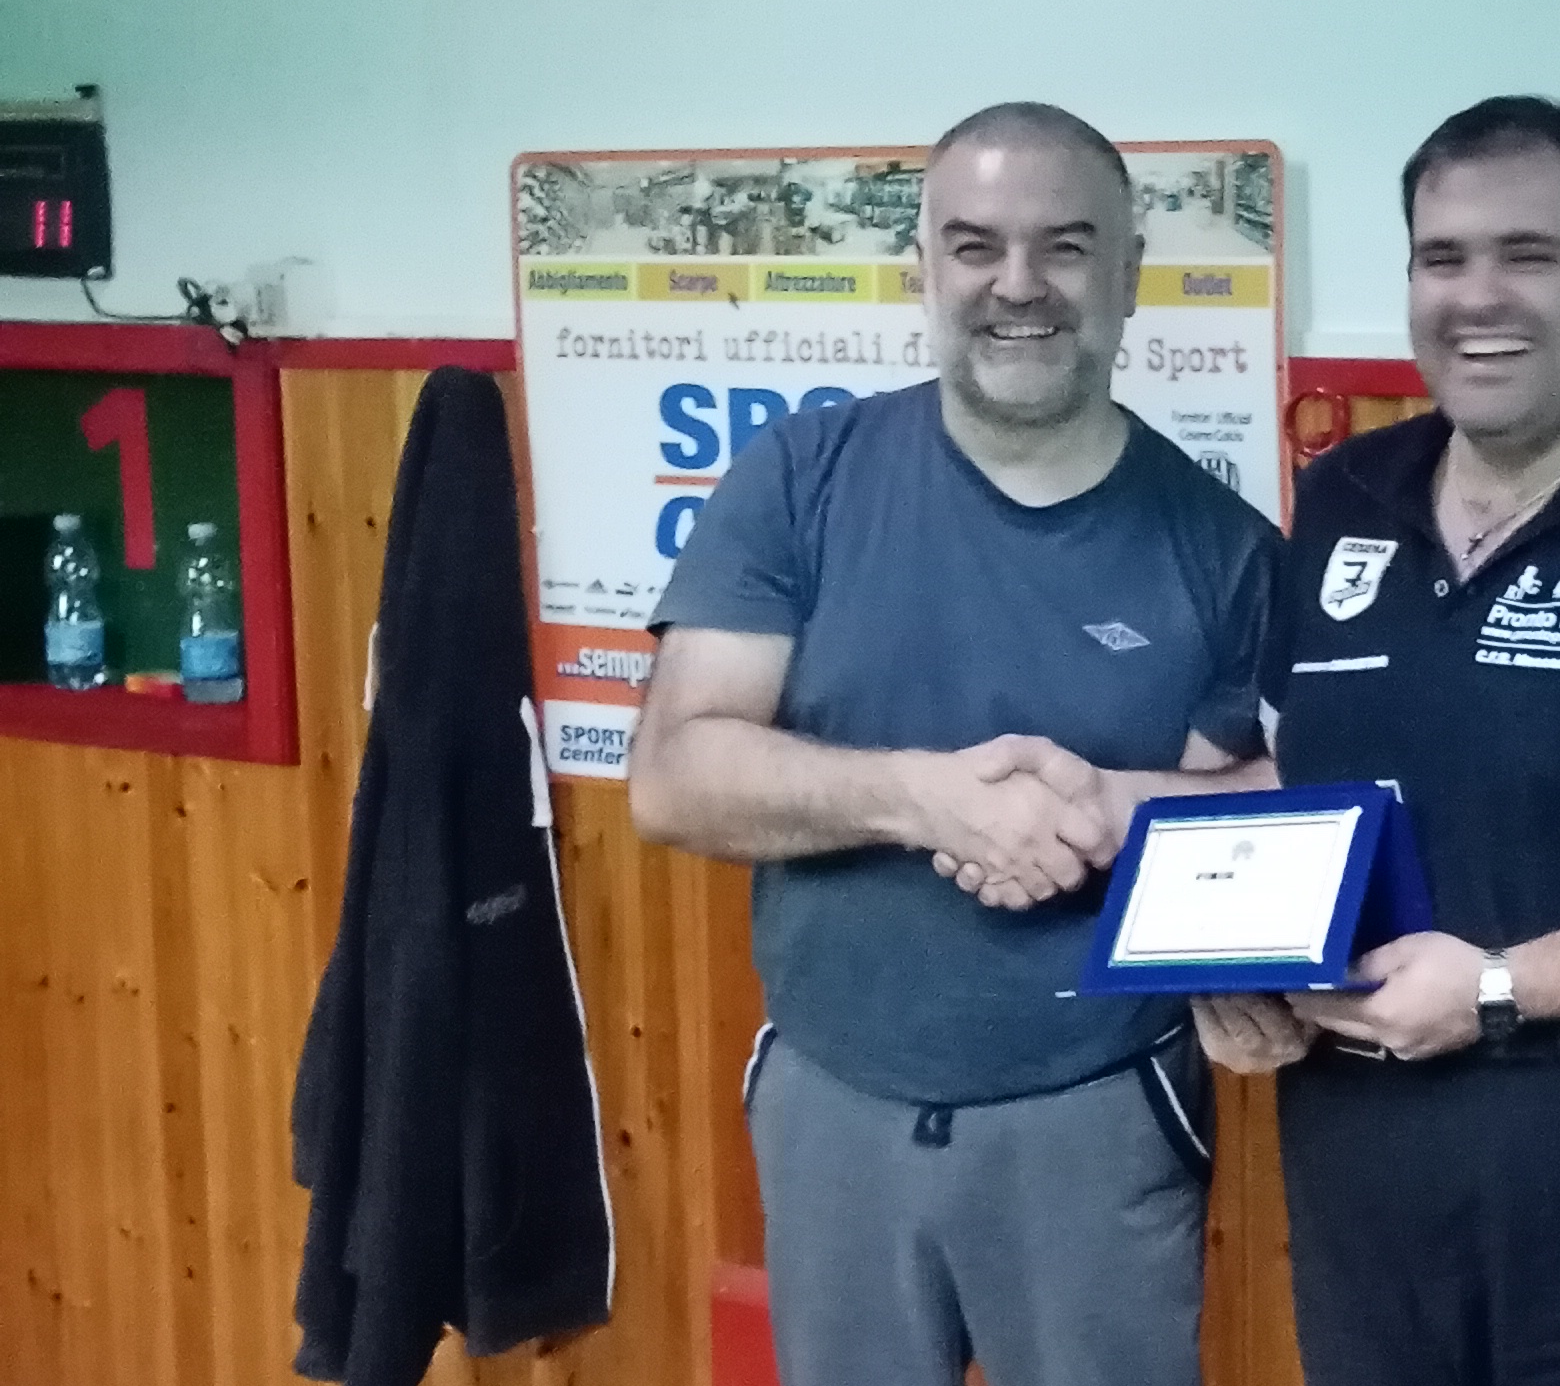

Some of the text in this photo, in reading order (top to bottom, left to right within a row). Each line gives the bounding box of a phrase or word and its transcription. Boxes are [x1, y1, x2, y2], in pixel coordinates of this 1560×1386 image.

[556, 325, 708, 363] fornitori
[724, 329, 884, 365] ufficiali
[1147, 337, 1249, 382] Sport
[80, 388, 156, 570] 1
[1486, 603, 1557, 628] Pronto
[560, 724, 626, 748] SPORT
[558, 746, 626, 765] center
